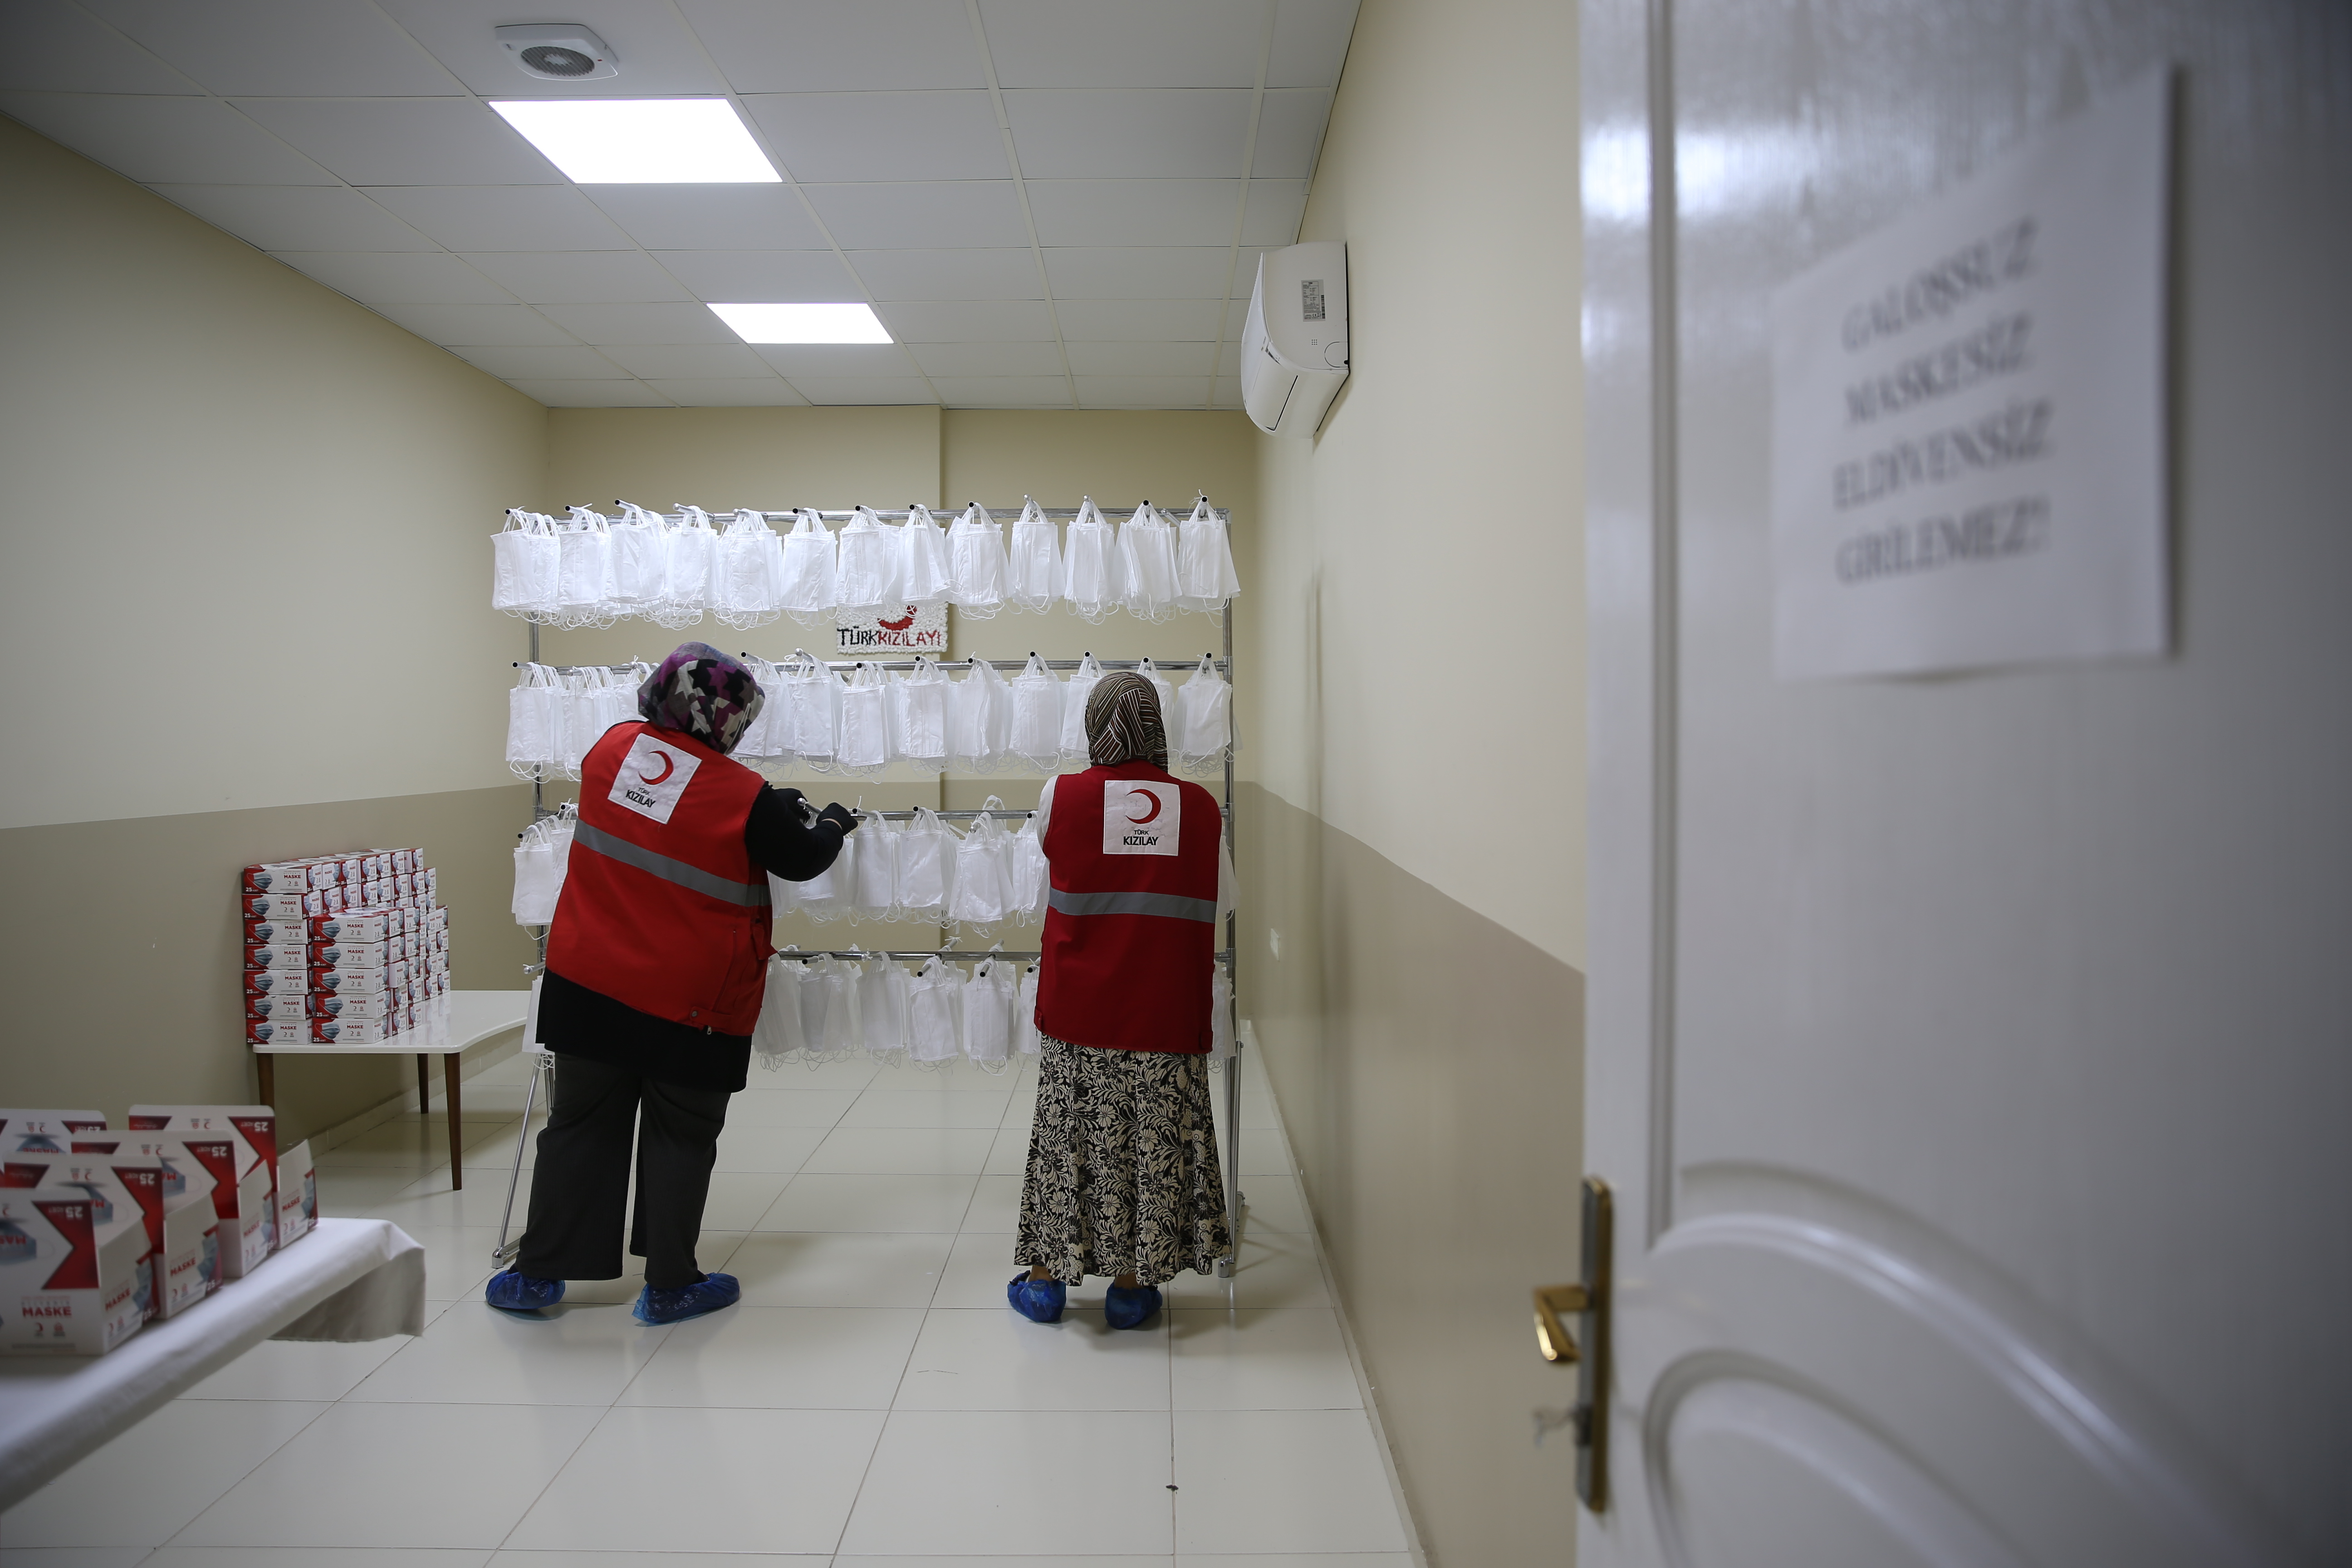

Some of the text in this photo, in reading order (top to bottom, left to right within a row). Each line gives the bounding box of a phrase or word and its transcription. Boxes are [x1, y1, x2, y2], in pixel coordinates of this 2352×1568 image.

[626, 790, 656, 808] KIZILAY
[1123, 836, 1159, 845] KIZILAY
[255, 1122, 268, 1131] 25
[211, 1147, 227, 1156] 25
[140, 1173, 155, 1185] 25
[282, 1196, 300, 1211] MASKE
[66, 1206, 83, 1219] 25
[170, 1257, 196, 1276] MASKE
[105, 1288, 130, 1311] MASKE
[22, 1307, 72, 1317] MASKE
